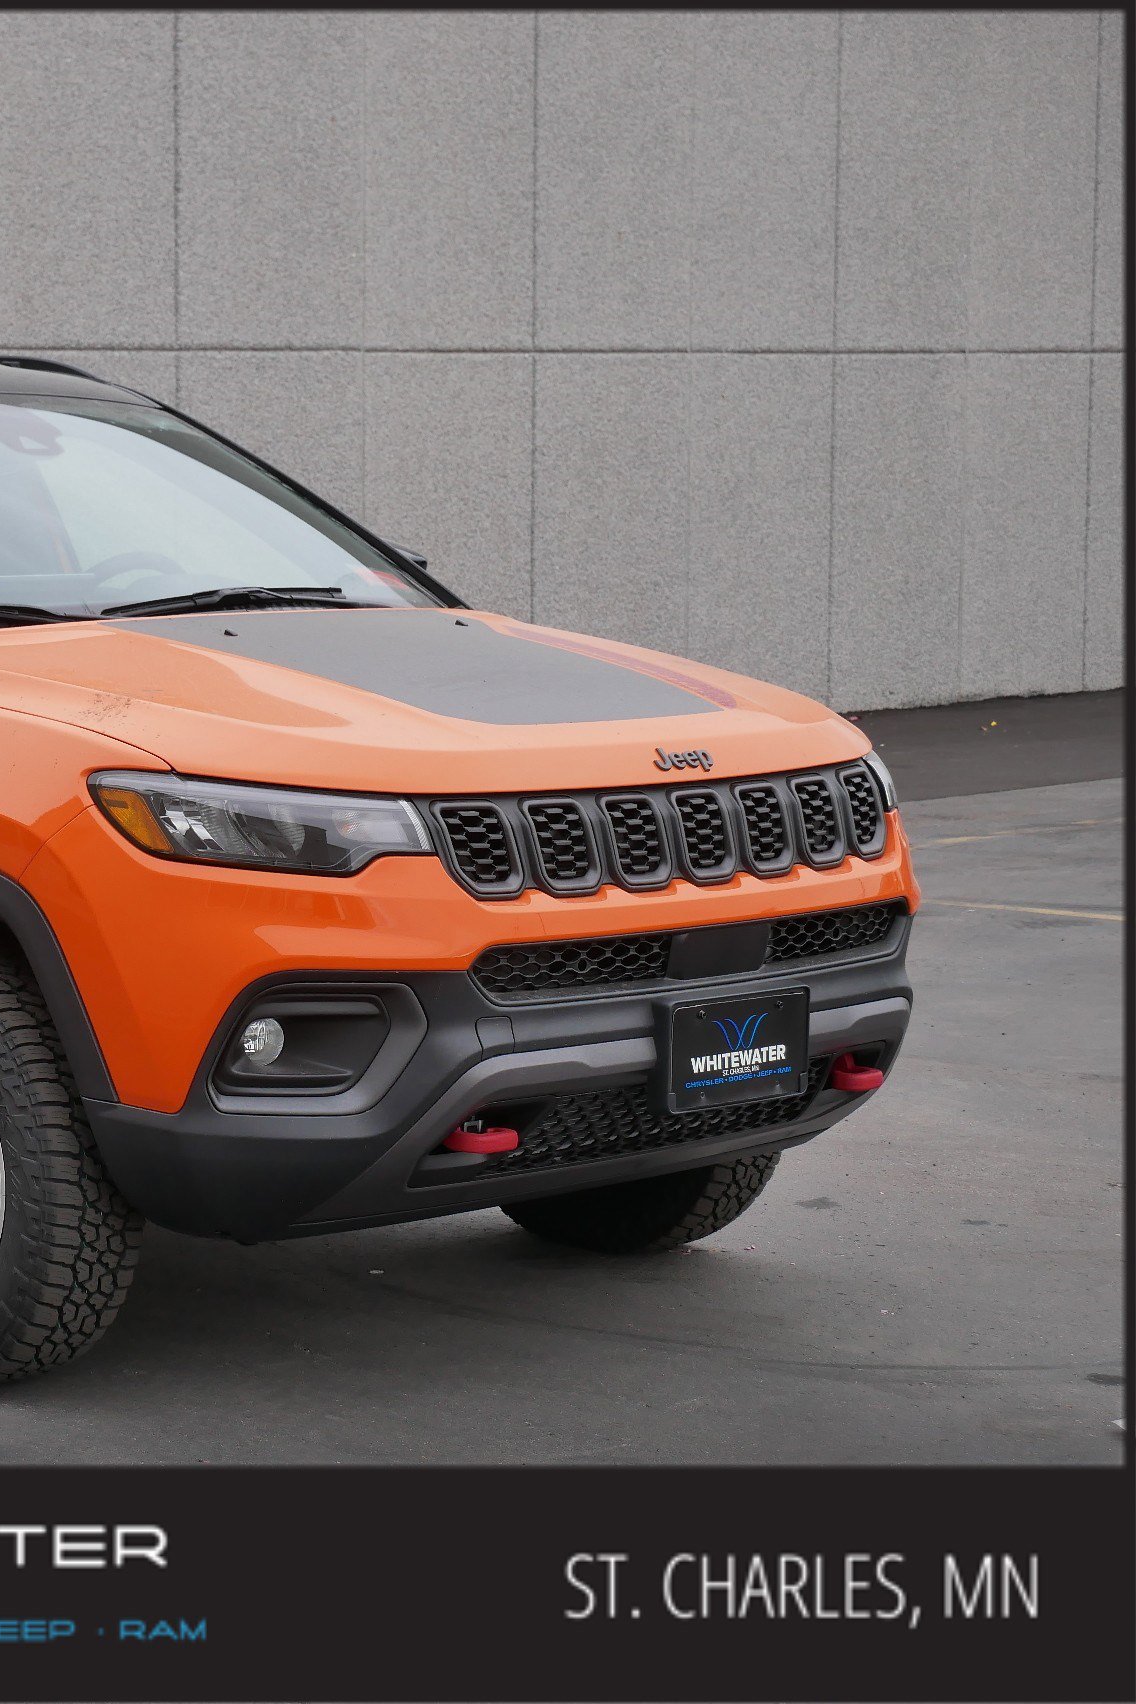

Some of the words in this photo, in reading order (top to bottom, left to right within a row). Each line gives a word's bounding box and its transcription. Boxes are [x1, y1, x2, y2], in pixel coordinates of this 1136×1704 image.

[653, 747, 714, 772] Jeep
[691, 1044, 786, 1074] WHITEWATER
[685, 1077, 724, 1089] CHRYSLER
[728, 1073, 753, 1083] DODGE
[756, 1069, 773, 1078] JEEP
[777, 1066, 792, 1075] RAM
